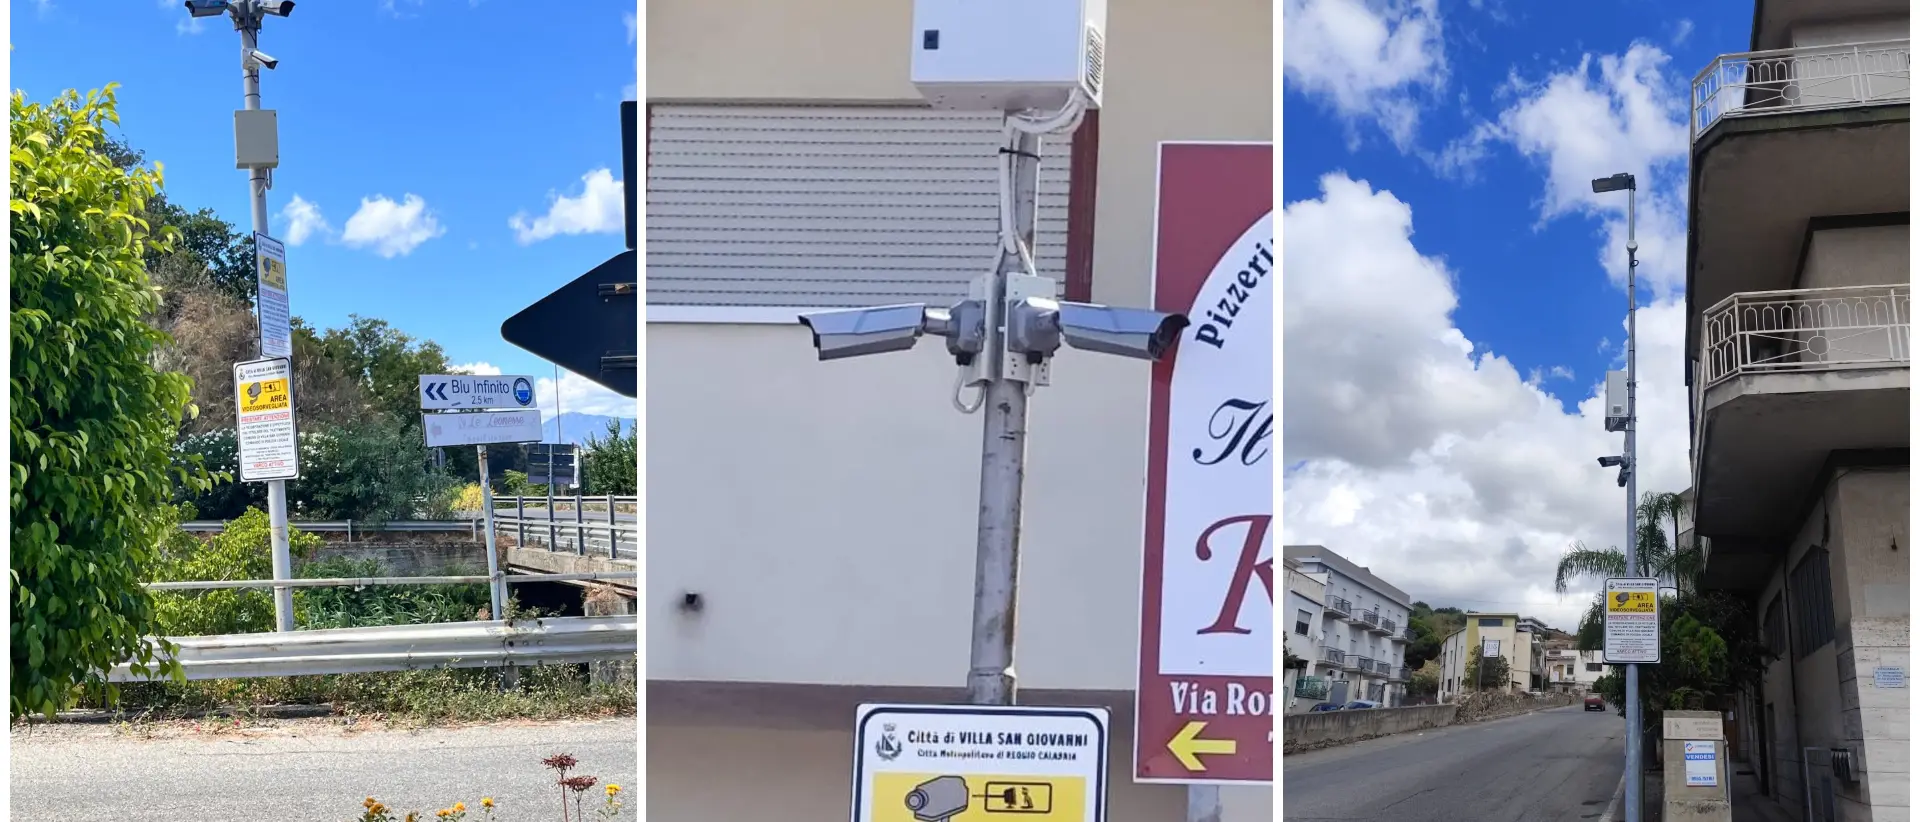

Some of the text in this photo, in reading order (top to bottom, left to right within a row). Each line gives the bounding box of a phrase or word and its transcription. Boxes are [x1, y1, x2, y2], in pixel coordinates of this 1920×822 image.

[1195, 237, 1273, 349] Pizzeri
[451, 379, 470, 394] Blu
[473, 379, 510, 394] Infinito
[270, 394, 287, 402] AREA
[483, 396, 494, 405] km
[242, 402, 288, 412] VIDEOSORVEGLIATA
[1170, 681, 1217, 715] Via
[908, 729, 1088, 747] Città di VILLA SAN GIOVANNI
